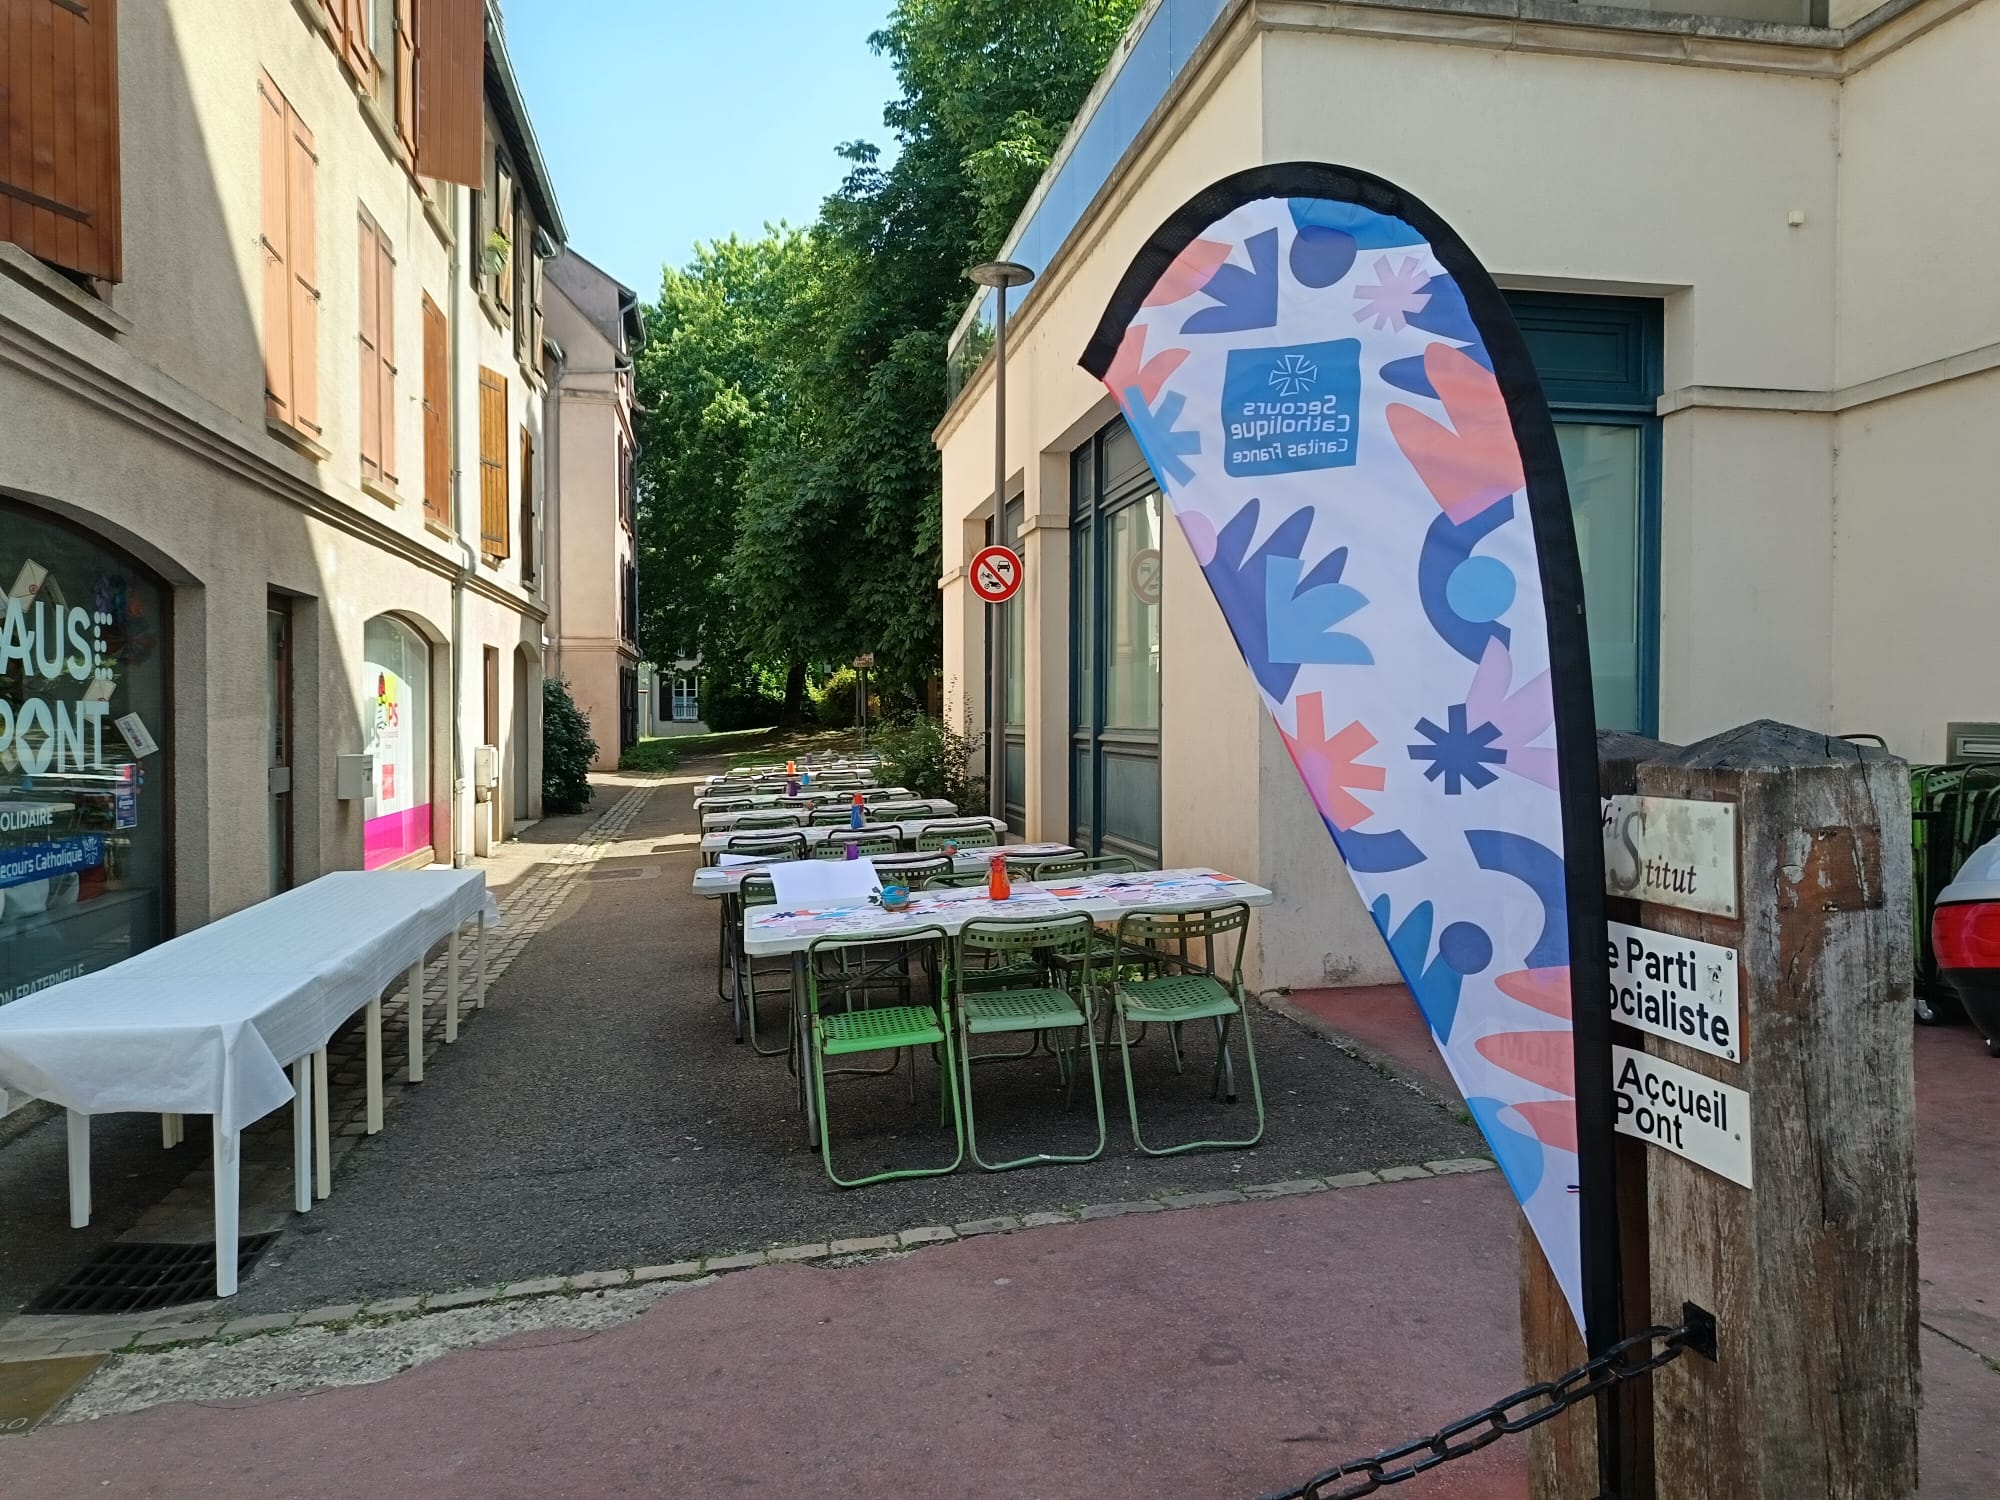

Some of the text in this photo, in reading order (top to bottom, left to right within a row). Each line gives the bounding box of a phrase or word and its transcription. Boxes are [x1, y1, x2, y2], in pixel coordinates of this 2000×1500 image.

[35, 848, 83, 871] Catholique
[1626, 936, 1697, 992] Parti
[1614, 1091, 1684, 1150] Pont
[1617, 1057, 1727, 1132] Accueil
